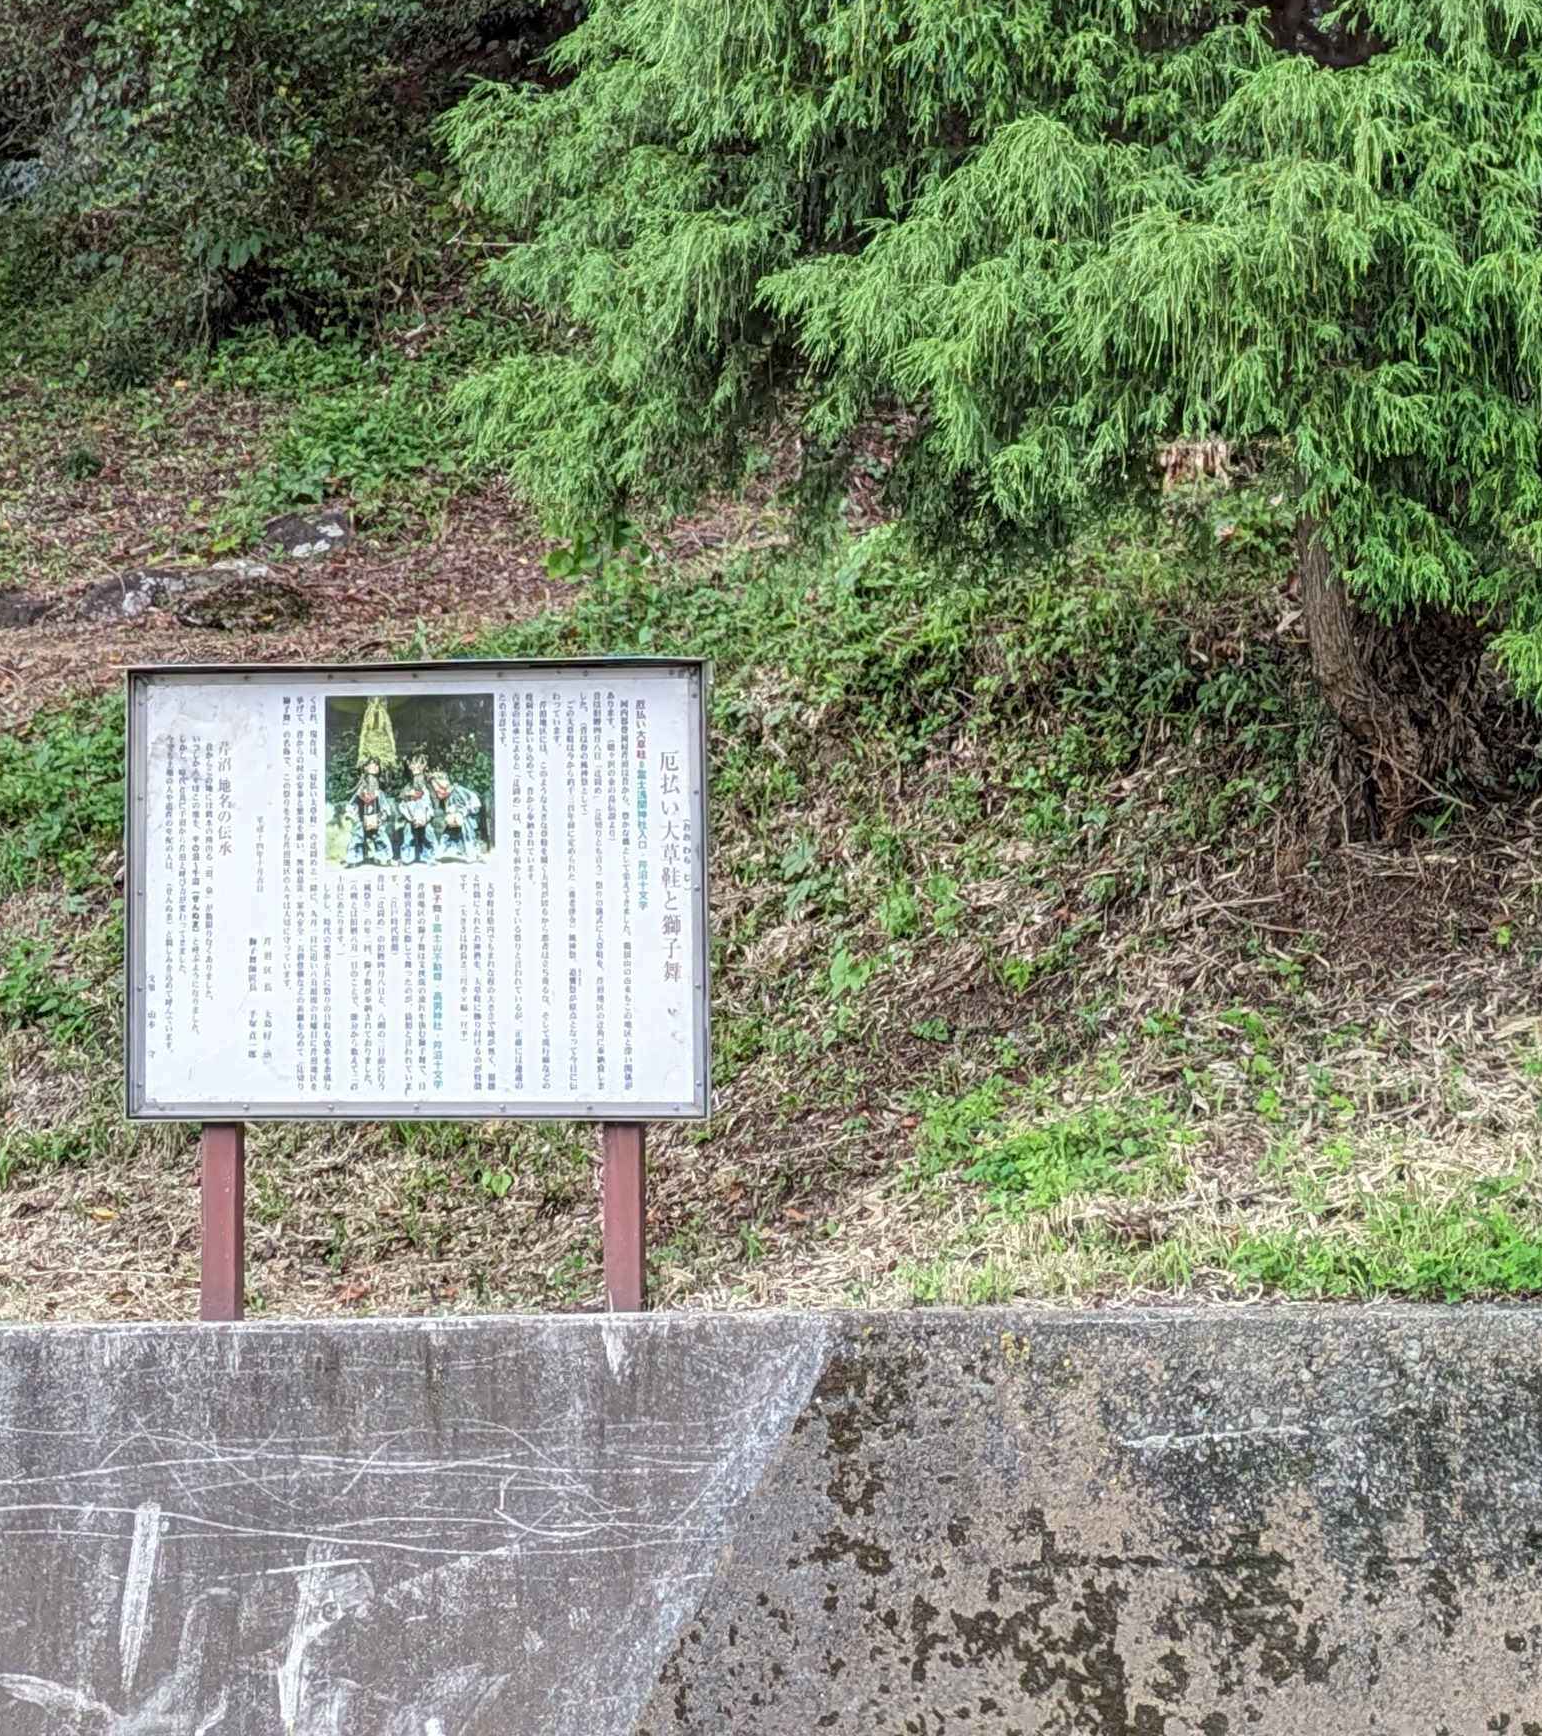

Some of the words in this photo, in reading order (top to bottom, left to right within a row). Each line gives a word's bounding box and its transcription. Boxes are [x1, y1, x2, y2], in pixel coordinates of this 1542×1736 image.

[217, 740, 232, 772] 芹沼
[217, 777, 233, 857] 地名の伝承
[659, 750, 682, 983] 厄払い大草鞋と獅子舞
